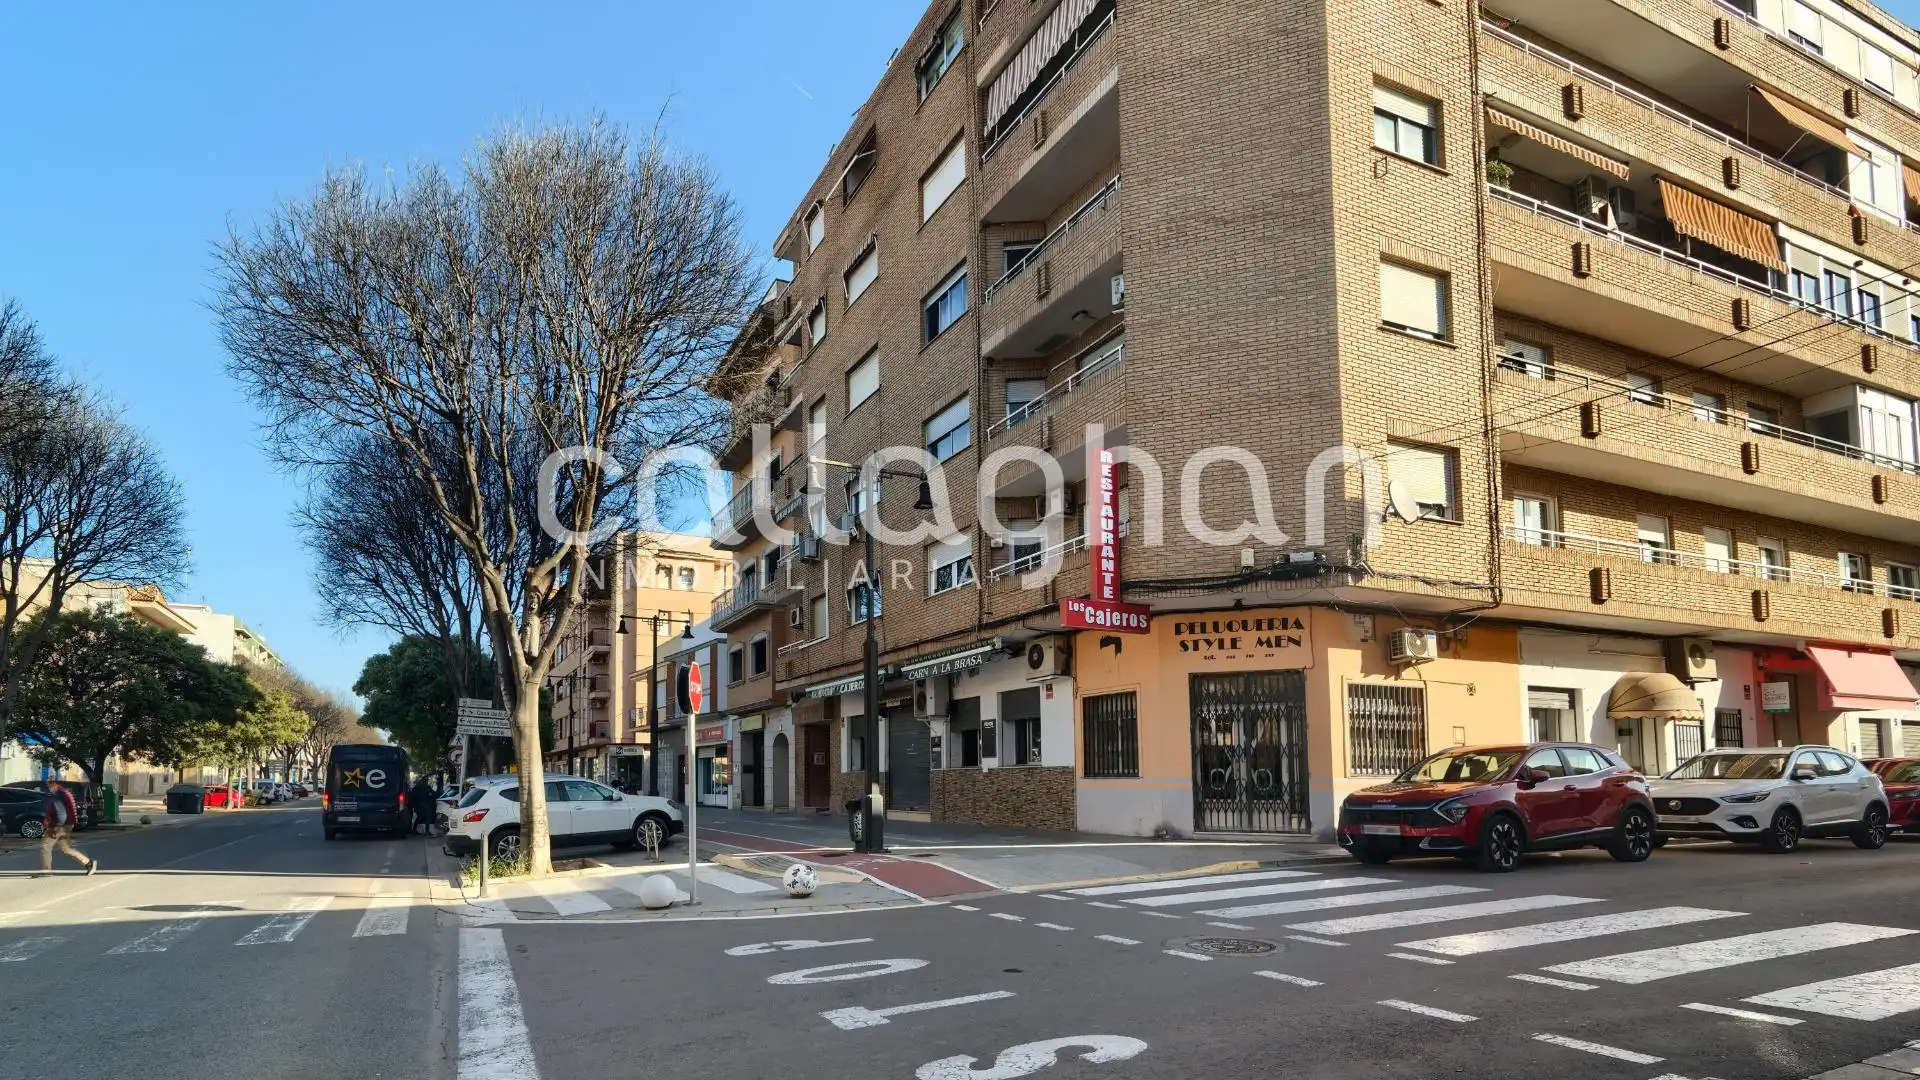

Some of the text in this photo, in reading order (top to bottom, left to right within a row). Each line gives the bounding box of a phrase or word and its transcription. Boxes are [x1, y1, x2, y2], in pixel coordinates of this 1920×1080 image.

[1100, 450, 1114, 599] RESTAURANTE
[1069, 600, 1148, 628] Los Cajeros
[1175, 617, 1305, 636] PELUQUERIA
[1179, 634, 1301, 652] STYLE MEN
[909, 654, 983, 680] CARN A LA BRASA
